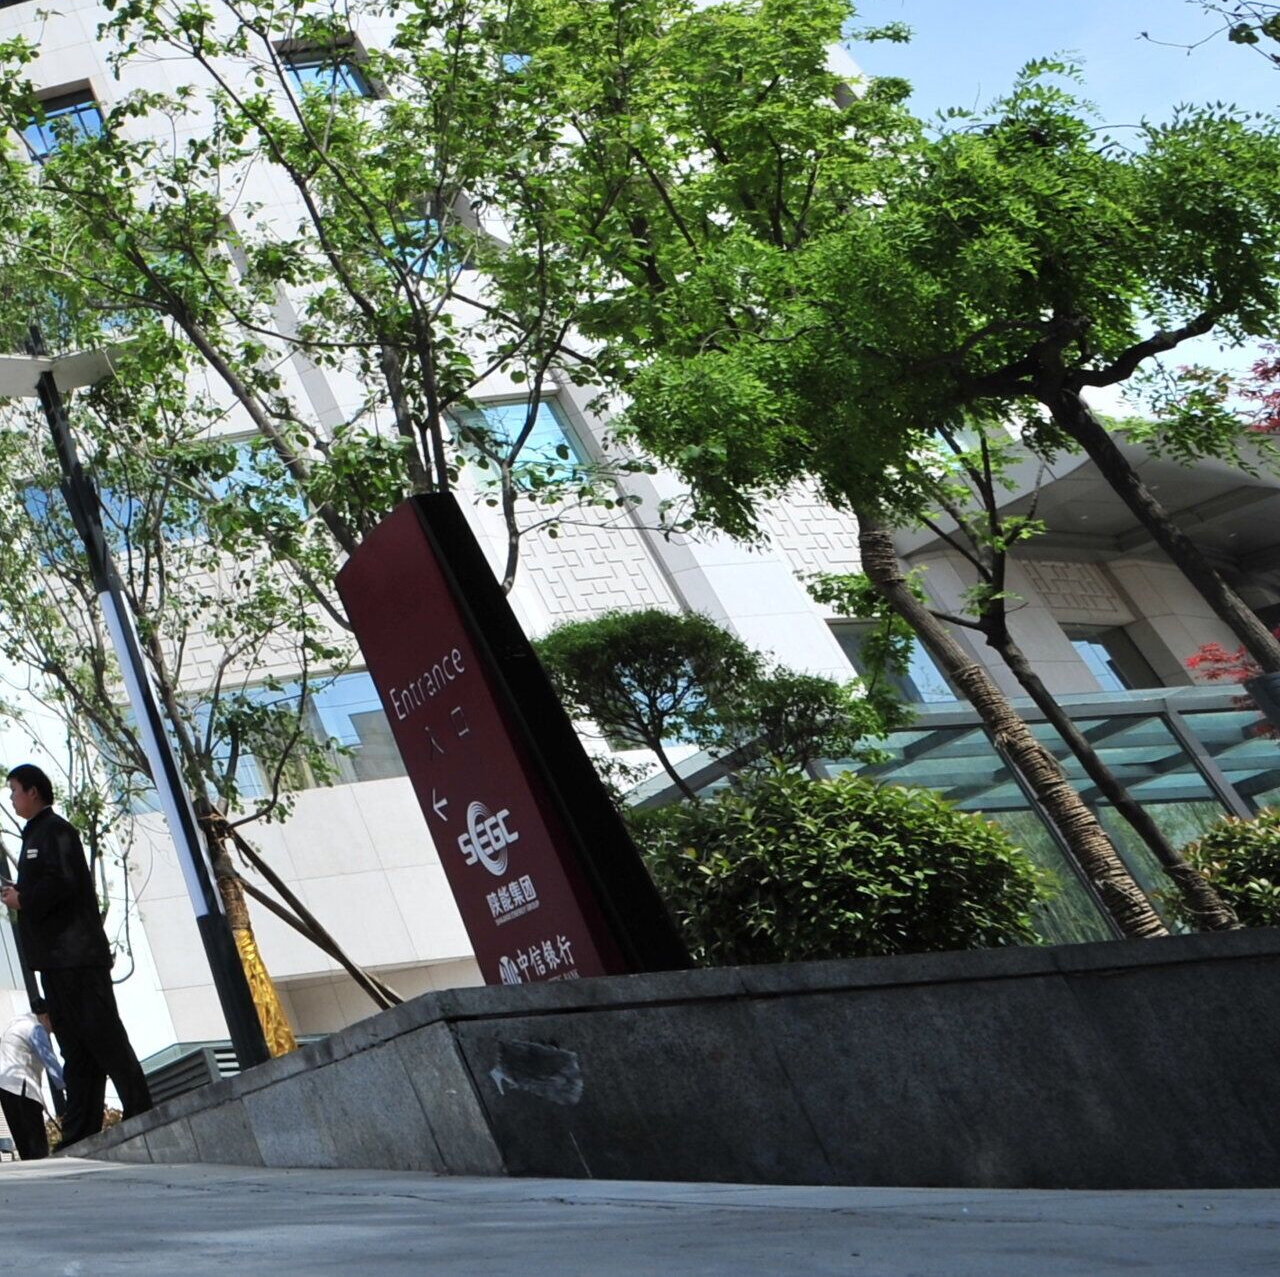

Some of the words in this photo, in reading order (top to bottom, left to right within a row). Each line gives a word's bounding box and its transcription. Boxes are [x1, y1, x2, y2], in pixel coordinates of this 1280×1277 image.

[389, 648, 466, 720] Entrance
[424, 705, 470, 762] 入口
[485, 874, 538, 918] 陕能集团
[516, 934, 575, 982] 中信银行
